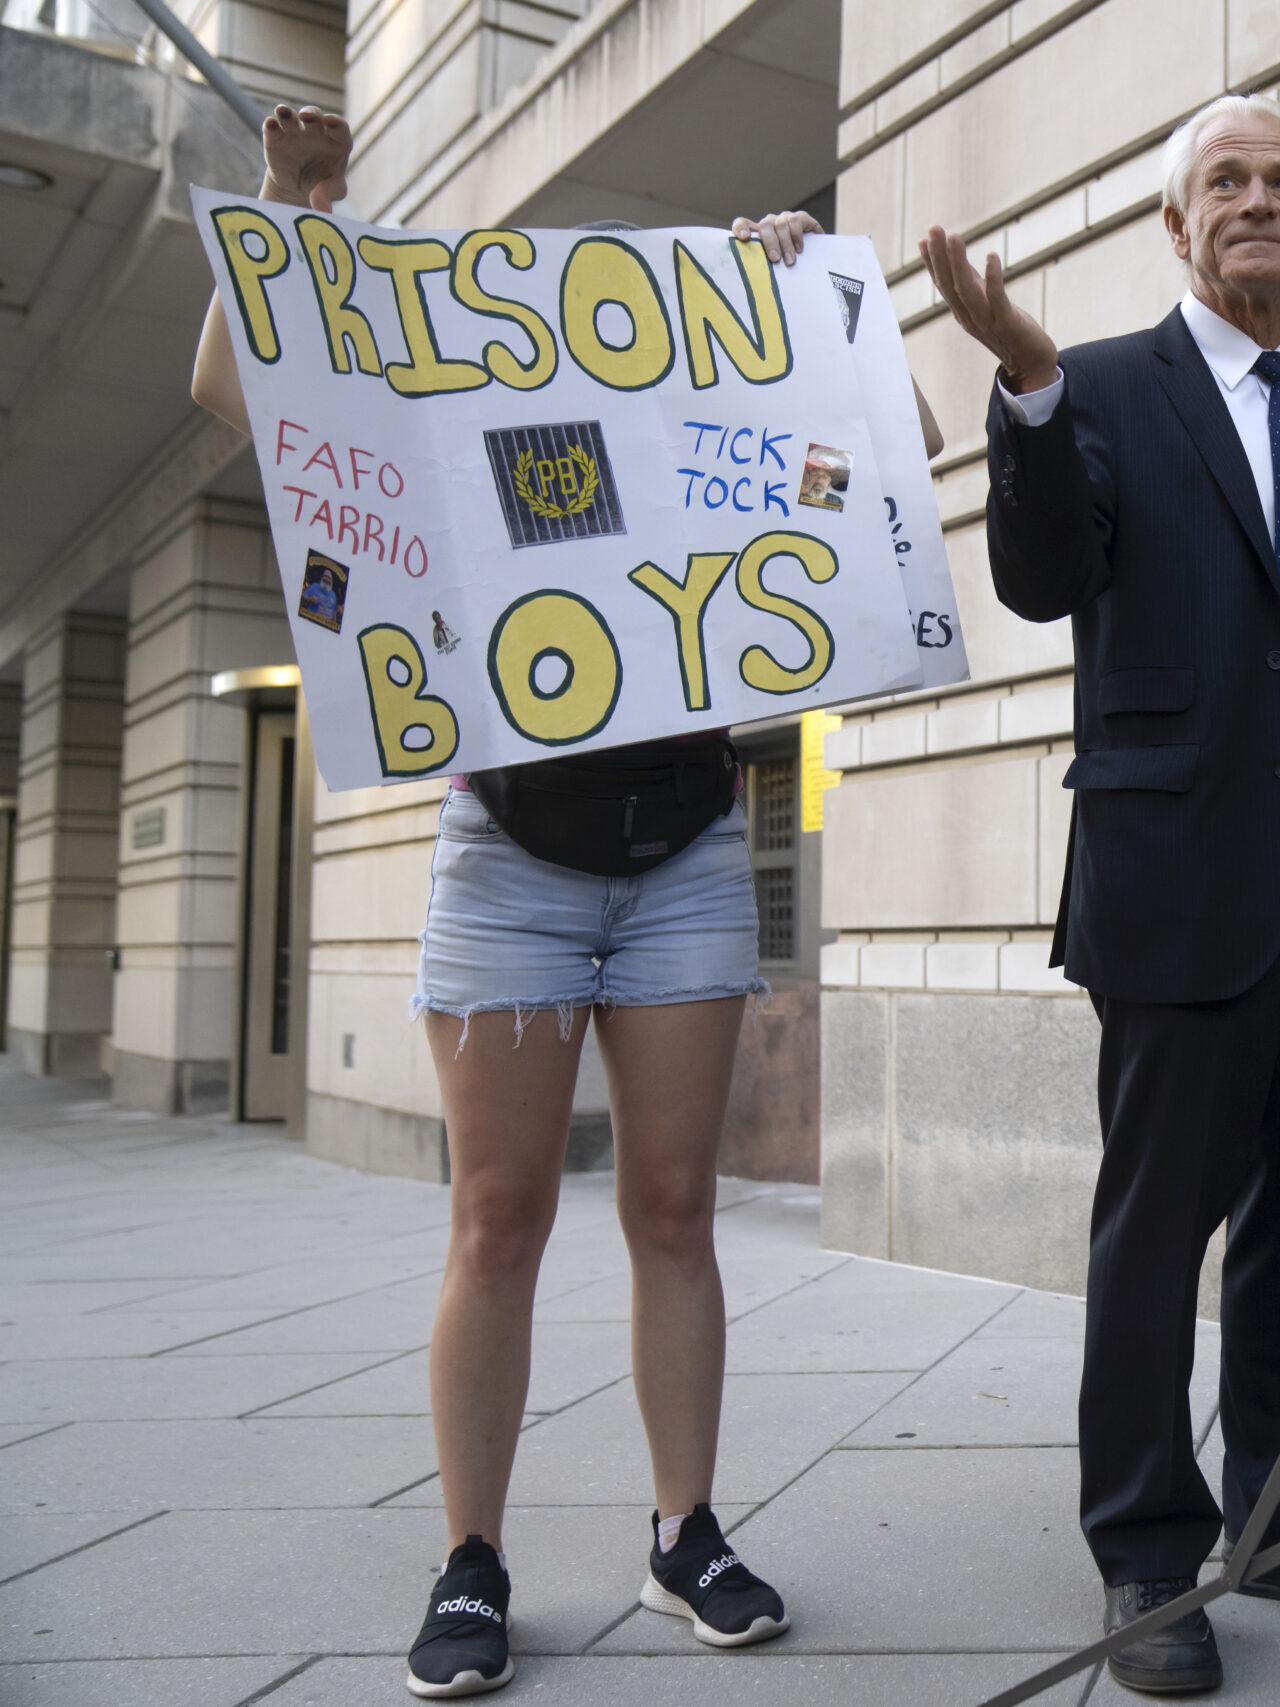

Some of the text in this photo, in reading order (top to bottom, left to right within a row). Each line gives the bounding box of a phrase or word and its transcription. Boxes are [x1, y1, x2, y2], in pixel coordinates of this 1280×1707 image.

[211, 206, 793, 398] PRISON
[275, 419, 404, 500] FAFO
[683, 421, 793, 471] TICK
[536, 459, 579, 498] PB
[678, 467, 789, 517] TOCK
[282, 485, 428, 578] TARRIO
[358, 530, 839, 778] BOYS
[698, 1554, 740, 1588] adida
[437, 1596, 502, 1624] adidas
